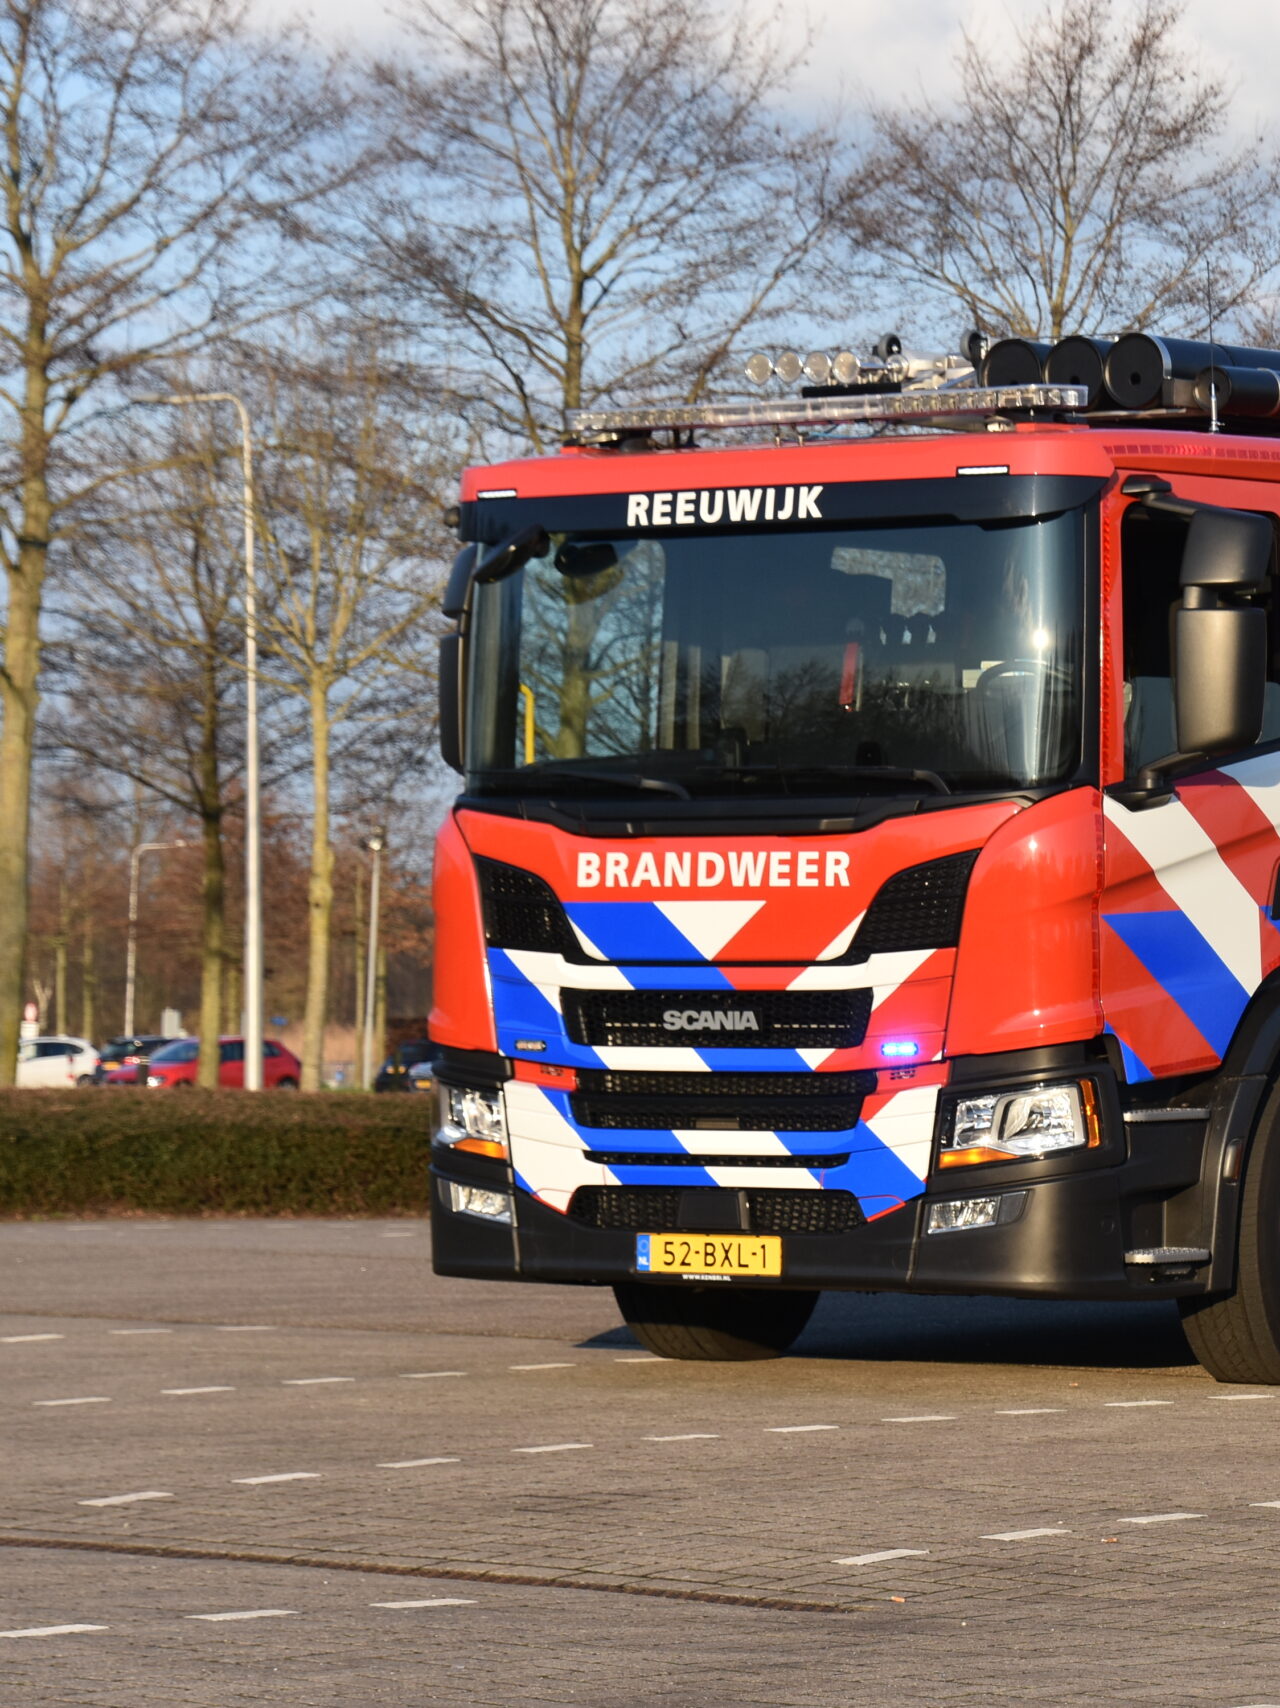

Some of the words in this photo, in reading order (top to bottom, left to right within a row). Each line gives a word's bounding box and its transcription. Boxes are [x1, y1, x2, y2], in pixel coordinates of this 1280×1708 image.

[626, 485, 824, 527] REEUWIJK
[577, 850, 851, 888] BRANDWEER
[662, 1010, 759, 1031] SCANIA
[638, 1256, 649, 1266] NL
[663, 1241, 767, 1269] 52-BXL-1
